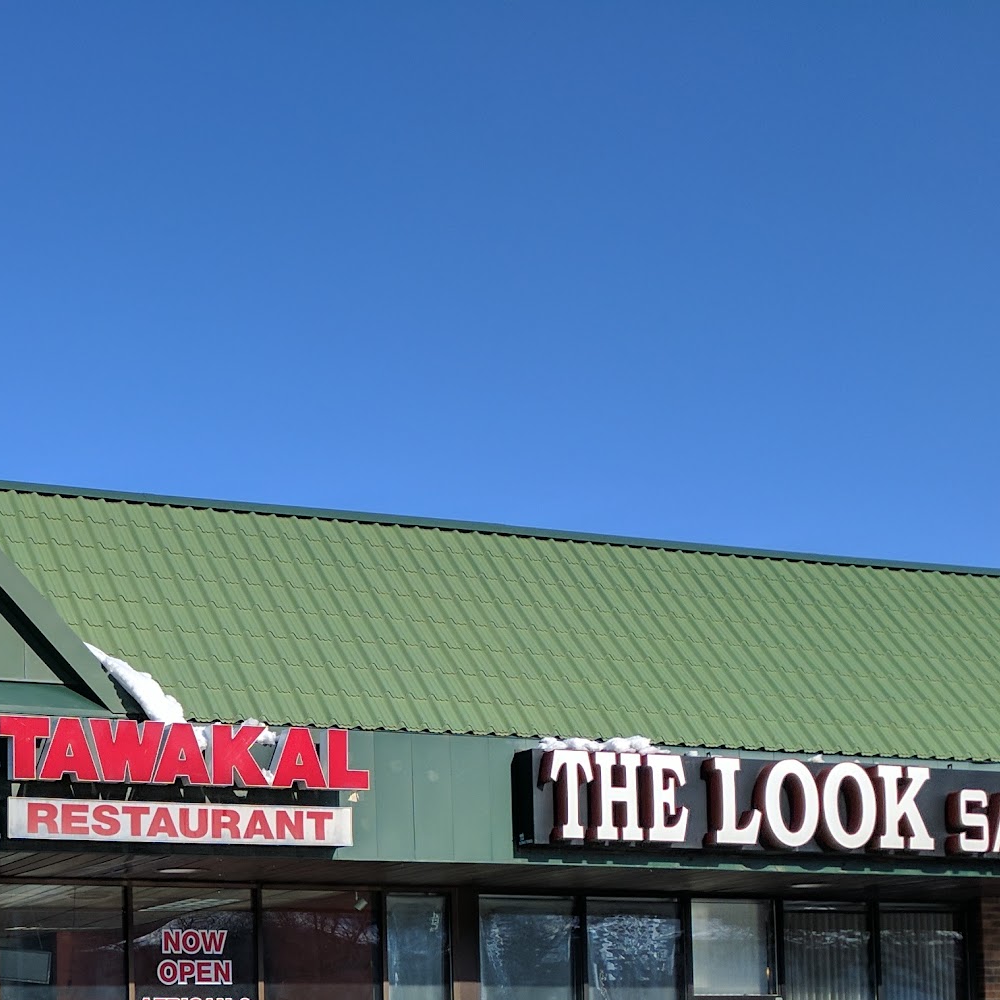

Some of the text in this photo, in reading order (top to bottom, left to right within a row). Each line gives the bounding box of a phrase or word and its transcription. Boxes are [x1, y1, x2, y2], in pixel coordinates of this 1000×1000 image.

[550, 750, 1000, 853] THE LOOK S
[27, 803, 334, 841] RESTAURANT
[162, 929, 227, 954] NOW
[157, 959, 233, 985] OPEN
